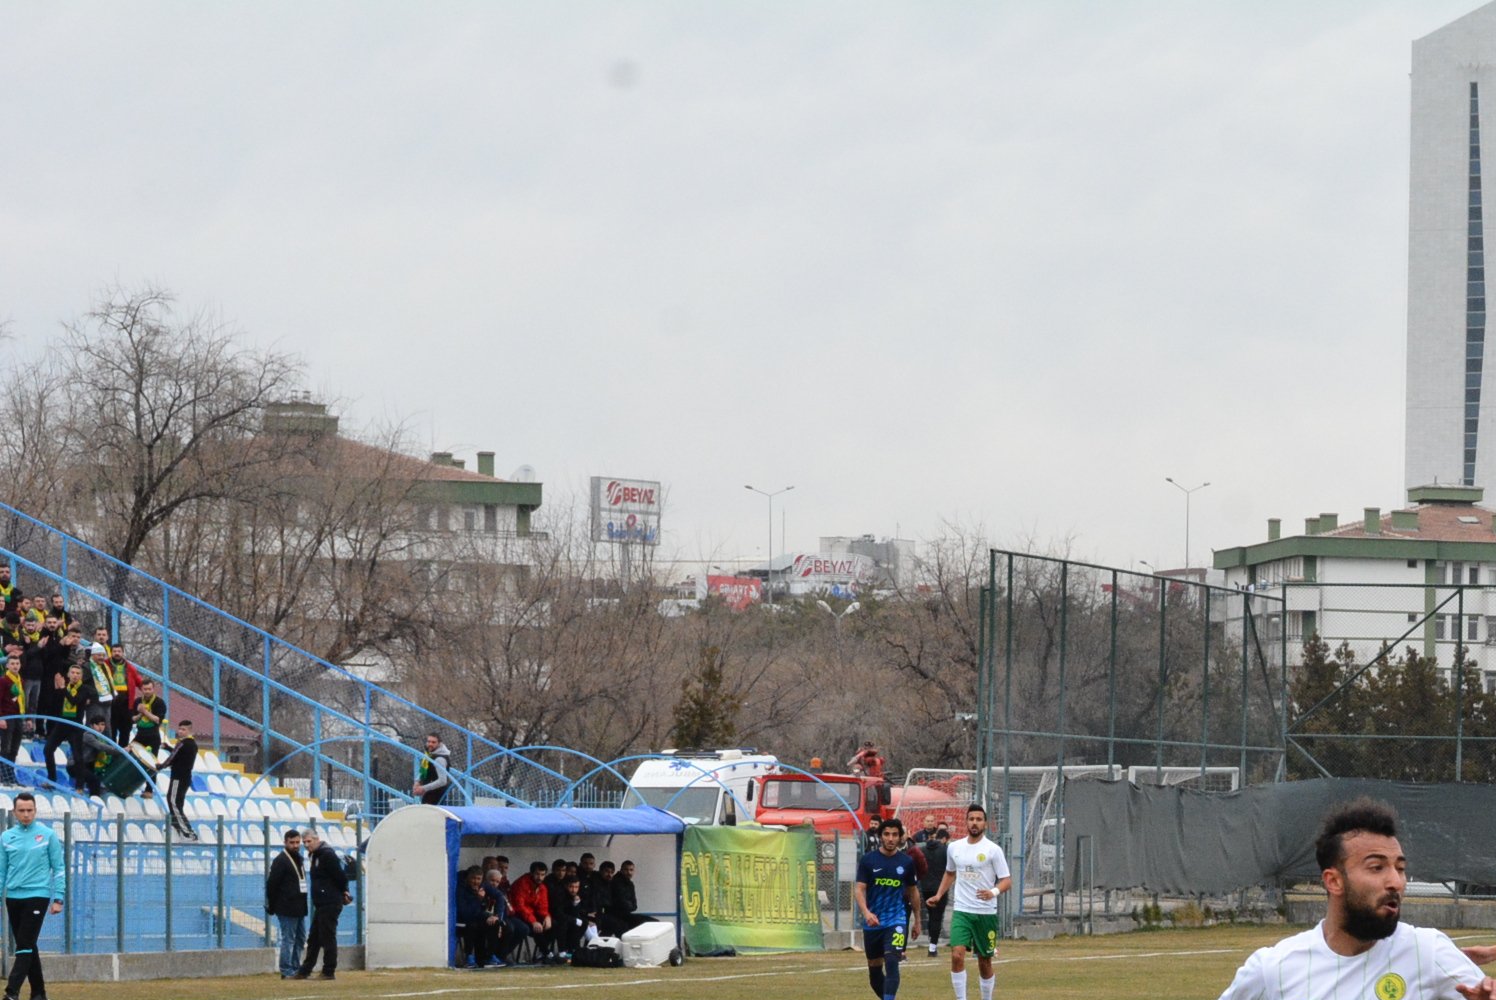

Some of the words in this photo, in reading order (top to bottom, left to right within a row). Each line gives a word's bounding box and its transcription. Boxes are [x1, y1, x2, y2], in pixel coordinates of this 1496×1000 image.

[623, 487, 655, 504] BEYAZ
[814, 559, 853, 574] BEYAZ
[875, 878, 901, 887] TCDD
[891, 933, 905, 947] 28
